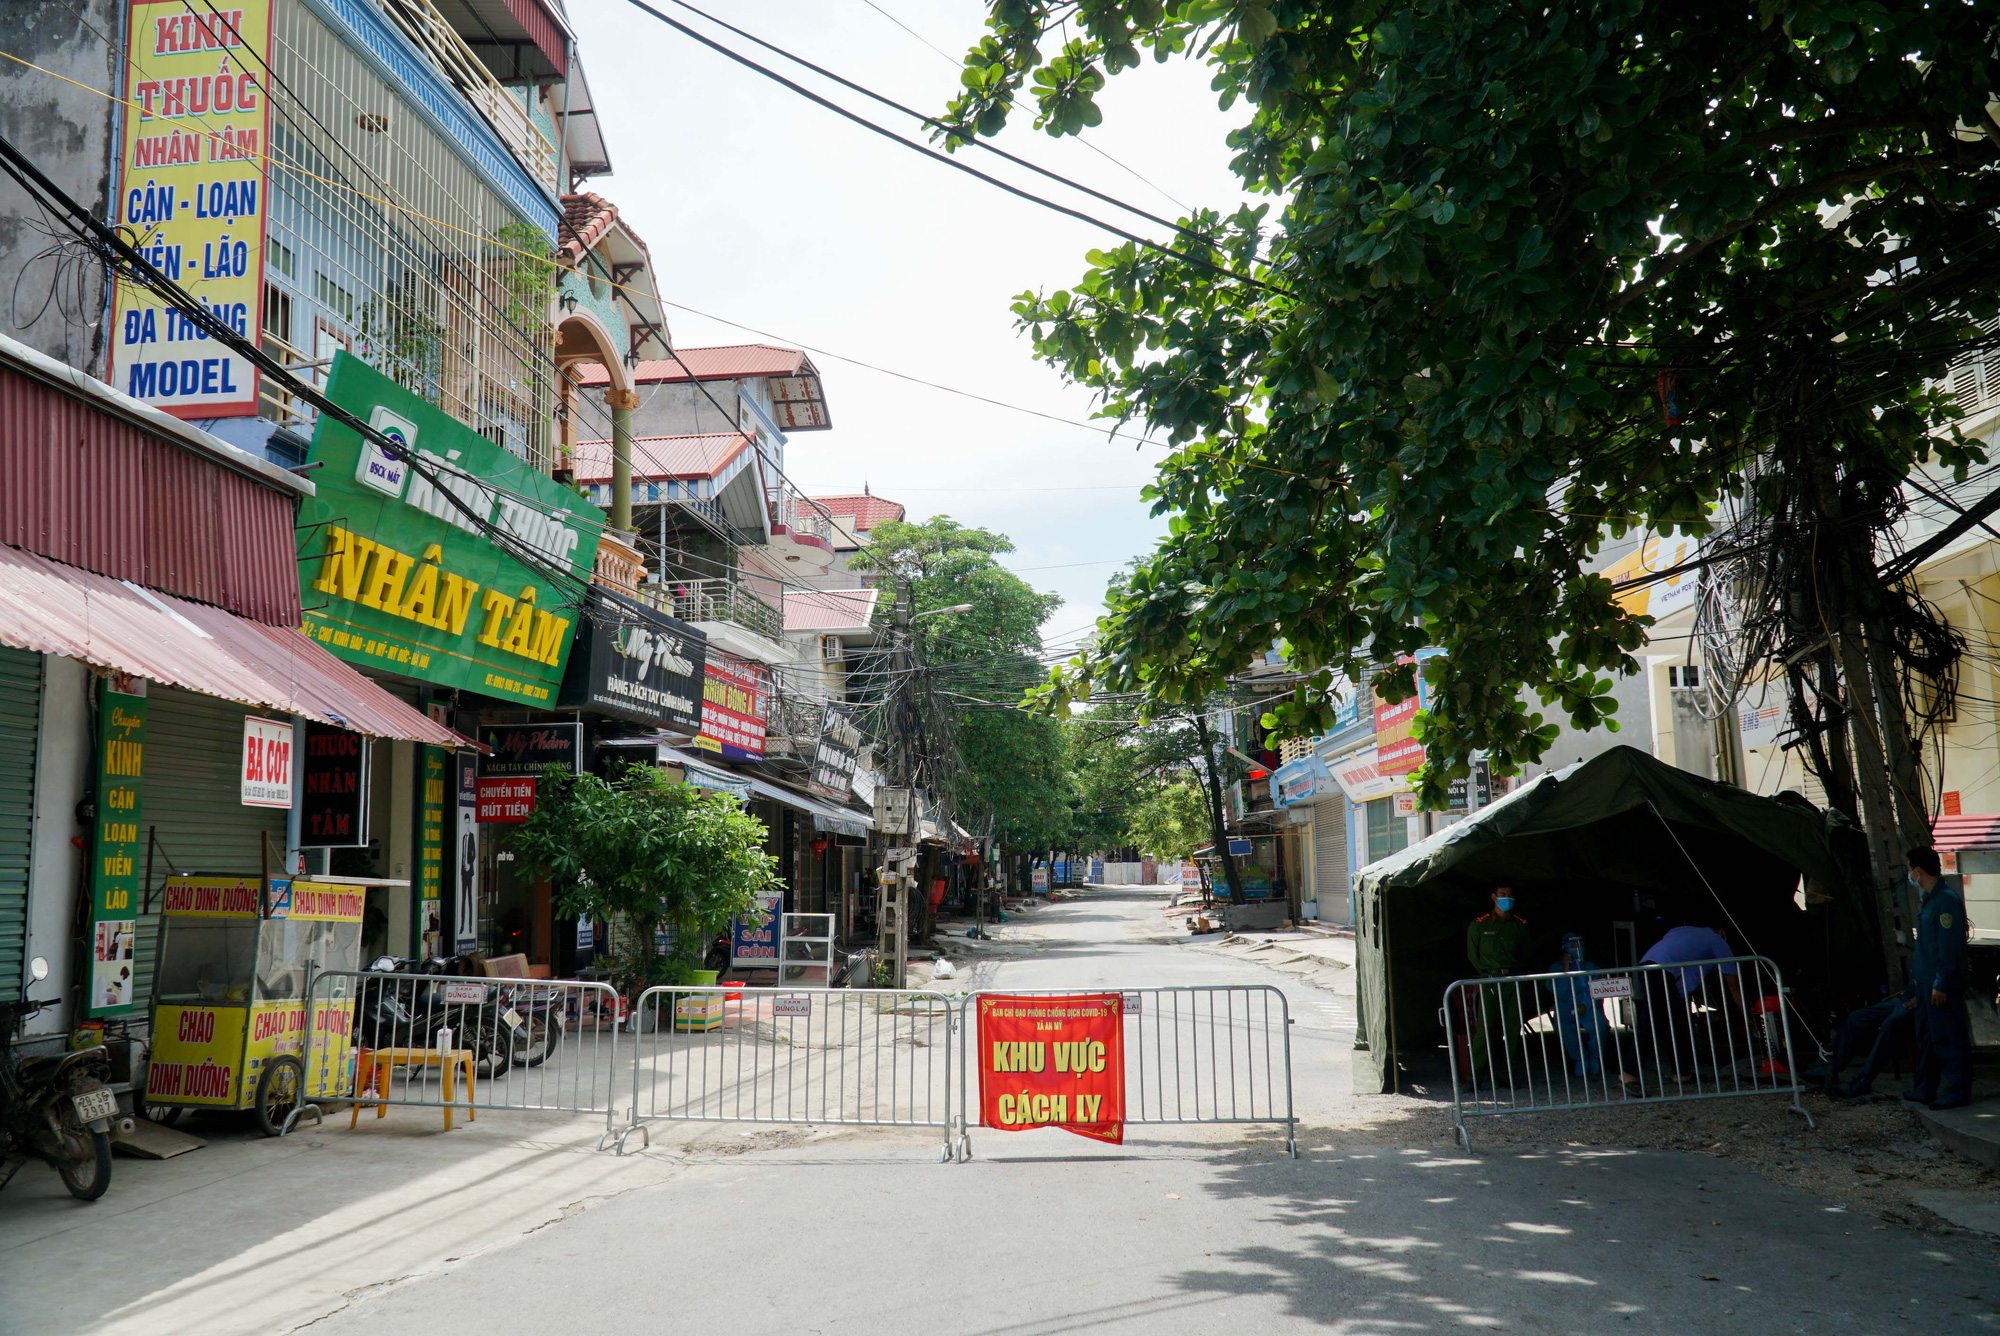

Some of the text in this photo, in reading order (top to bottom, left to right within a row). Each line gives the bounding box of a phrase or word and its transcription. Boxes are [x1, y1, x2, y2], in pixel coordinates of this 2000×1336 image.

[154, 3, 243, 56] KÍNH
[135, 56, 258, 122] THUỐC
[134, 124, 259, 170] NHÂN TÂM
[127, 179, 174, 231] CẬN
[195, 180, 257, 226] LOẠN
[203, 234, 248, 279] LÃO
[124, 308, 156, 345] ĐA
[129, 358, 237, 398] MODEL
[370, 461, 387, 479] BSCK
[313, 526, 570, 668] NHÂN TÂM
[1661, 581, 1695, 602] VIETNAM POST
[607, 674, 629, 696] HÀNG
[629, 682, 649, 701] XÁCH
[648, 688, 660, 705] TAY
[660, 691, 678, 710] CHÍNH
[677, 696, 694, 714] HÀNG
[106, 734, 143, 777] KÍNH
[309, 729, 359, 756] THUỐC
[530, 730, 571, 750] Phẩm
[247, 728, 290, 785] BÀ CÓT
[487, 762, 506, 772] XÁCH
[508, 763, 522, 772] TAY
[307, 766, 357, 793] NHÂN
[426, 774, 444, 805] KÍNH
[480, 783, 512, 798] CHUYỂN
[109, 786, 135, 814] CẬN
[481, 802, 503, 817] RÚT
[104, 823, 137, 847] LOẠN
[311, 808, 350, 836] TÂM
[104, 849, 132, 876] VIỄN
[106, 886, 129, 910] LÃO
[165, 881, 192, 911] CHÁO
[195, 887, 220, 912] DINH
[222, 881, 259, 914] DƯỠNG
[294, 887, 316, 915] CHÁO
[317, 891, 336, 916] DINH
[338, 888, 363, 918] DƯỠNG
[738, 943, 775, 958] GÒN
[1594, 987, 1615, 995] DỪNG
[254, 1006, 286, 1043] CHÁO
[289, 1009, 308, 1033] DIN
[776, 1004, 809, 1014] DỪNG LẠI
[993, 1008, 1004, 1017] BAN
[1028, 1007, 1046, 1018] PHÒNG
[1048, 1006, 1066, 1018] CHỐNG
[1067, 1009, 1081, 1020] DỊCH
[1082, 1008, 1108, 1017] COVID-19
[178, 1006, 216, 1044] CHÁO
[1045, 1022, 1053, 1031] AN
[993, 1038, 1106, 1079] KHU VỰC
[148, 1062, 184, 1096] DINH
[183, 1058, 231, 1099] DƯỠNG
[999, 1090, 1102, 1125] CÁCH LY
